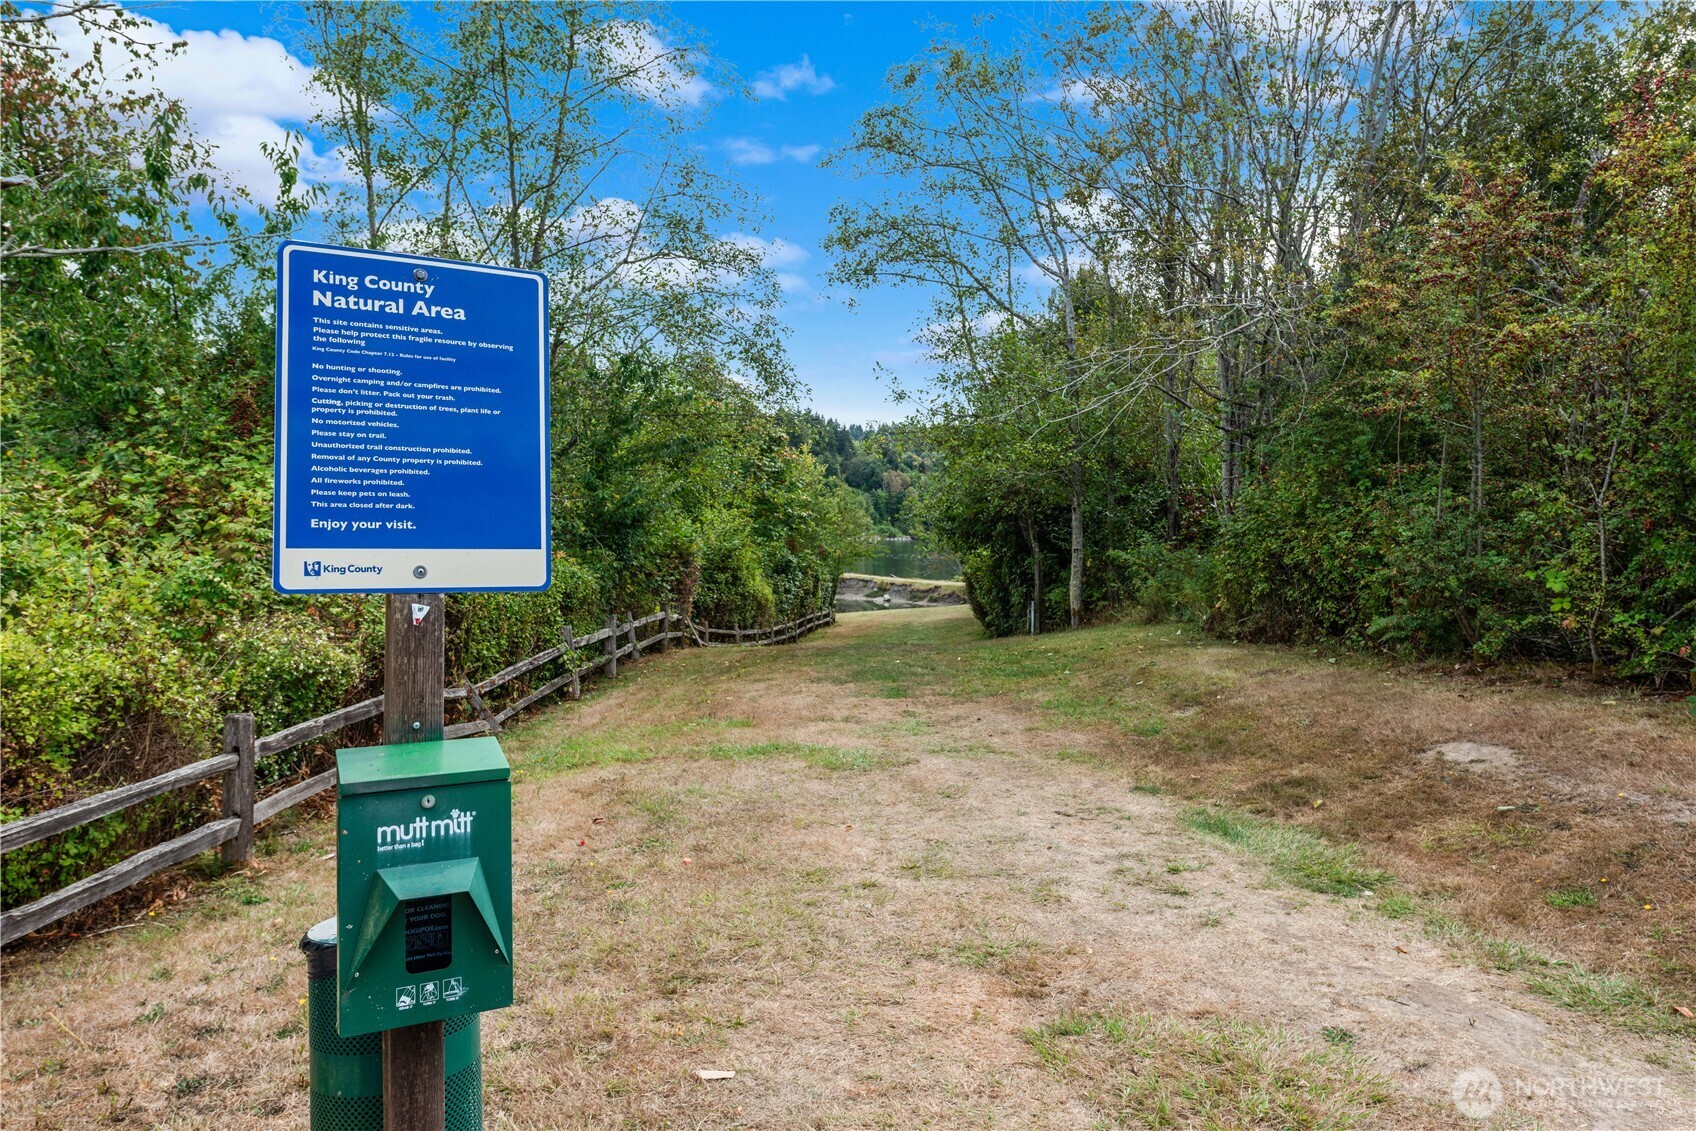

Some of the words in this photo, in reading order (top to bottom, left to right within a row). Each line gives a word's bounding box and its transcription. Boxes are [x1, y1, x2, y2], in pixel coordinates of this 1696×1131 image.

[313, 269, 359, 290] King
[365, 276, 435, 298] County
[313, 290, 404, 314] Natural
[411, 299, 467, 320] Area
[350, 320, 383, 329] contains
[385, 323, 419, 332] sensitive
[313, 327, 339, 335] Please
[341, 328, 359, 337] help
[360, 331, 390, 340] protect
[408, 334, 433, 344] fragile
[434, 338, 466, 346] resource
[468, 340, 477, 348] by
[478, 341, 514, 351] observing
[329, 336, 366, 346] following
[326, 364, 356, 374] hunting
[368, 367, 403, 376] shooting.
[311, 375, 351, 384] Overnight
[353, 378, 385, 386] camping
[386, 379, 412, 387] and/or
[414, 381, 449, 390] campfires
[463, 385, 502, 394] prohibited.
[312, 386, 336, 394] Please
[311, 398, 344, 407] Cutting,
[345, 400, 373, 408] picking
[384, 402, 428, 411] destruction
[311, 406, 346, 415] property
[356, 409, 398, 417] prohibited.
[311, 442, 365, 450] Unauthorized
[373, 455, 401, 463] County
[402, 457, 435, 465] property
[444, 458, 483, 466] prohibited.
[349, 466, 388, 474] beverages
[310, 519, 348, 530] Enjoy
[351, 520, 382, 530] your
[385, 520, 416, 529] visit.
[323, 564, 346, 575] King
[348, 565, 383, 574] County
[377, 816, 429, 843] mutt
[406, 925, 449, 934] OGIPOT.com
